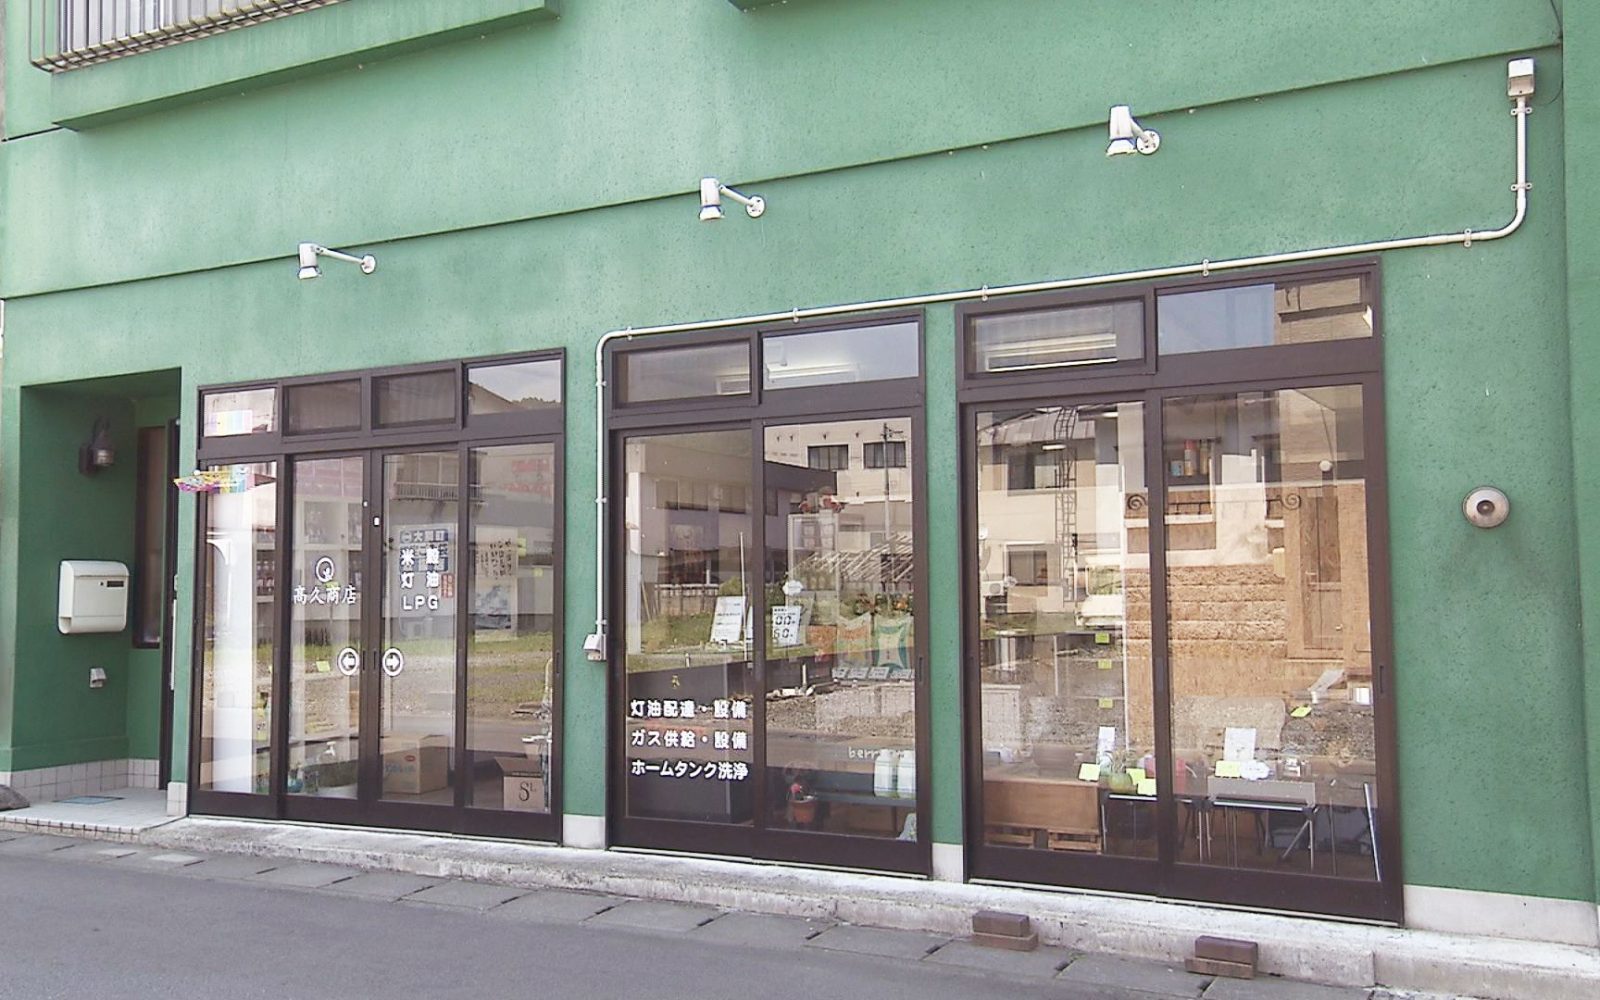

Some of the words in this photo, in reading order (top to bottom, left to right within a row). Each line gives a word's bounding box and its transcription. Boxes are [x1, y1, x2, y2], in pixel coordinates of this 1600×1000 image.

[401, 571, 440, 589] 灯油
[402, 595, 439, 611] LPG
[631, 729, 748, 750] ガス供給・設備
[631, 760, 749, 780] ホームタンク洗浄
